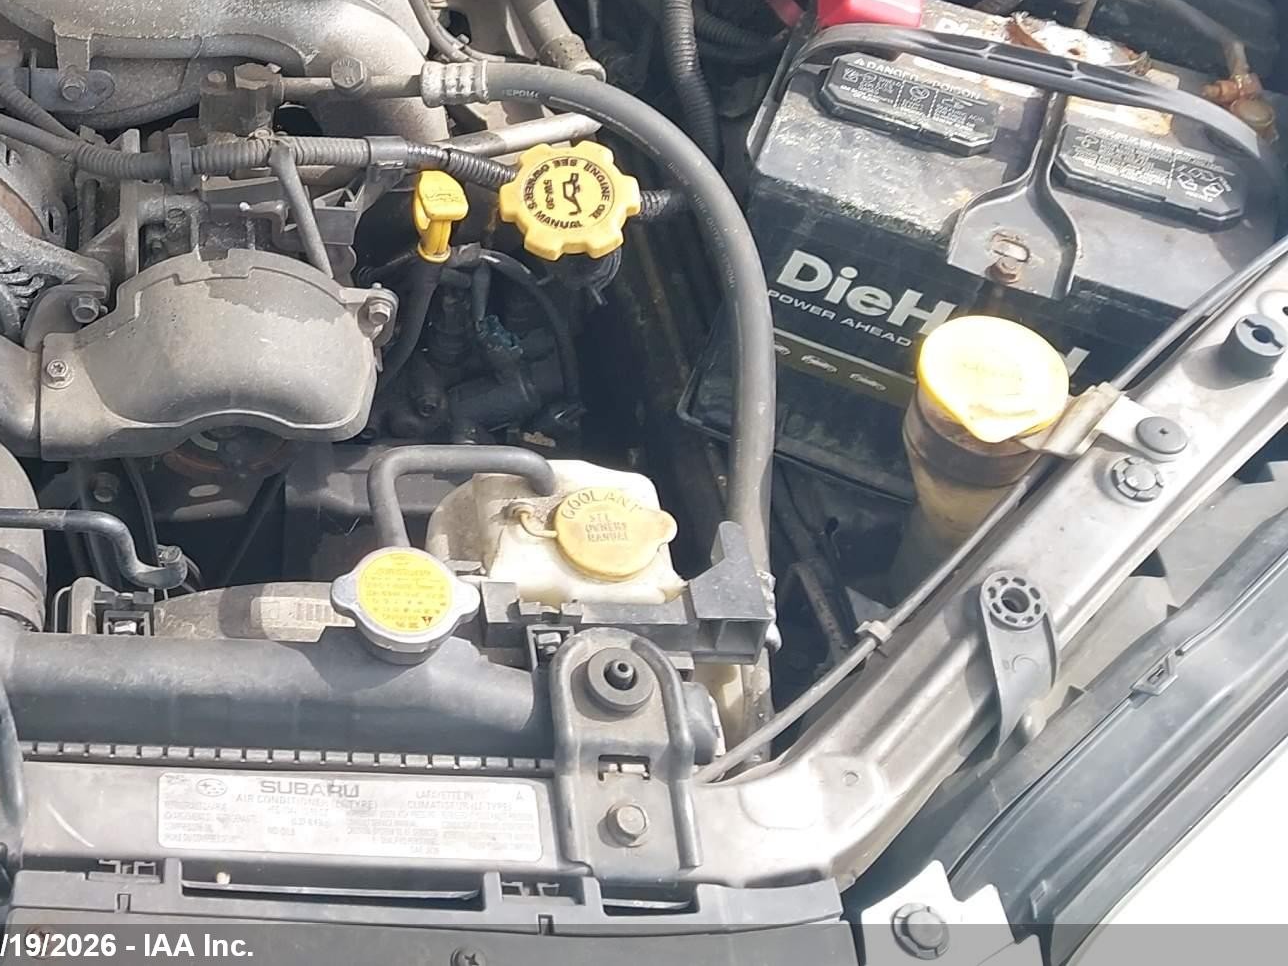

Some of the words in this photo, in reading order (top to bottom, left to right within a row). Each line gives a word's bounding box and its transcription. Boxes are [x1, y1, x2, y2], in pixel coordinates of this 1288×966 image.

[552, 158, 578, 169] SEE
[584, 162, 611, 201] ENGINE
[534, 210, 583, 229] MANUAL
[768, 289, 837, 321] POWER
[841, 317, 914, 348] AHEAD
[561, 490, 642, 520] COOLANT
[236, 794, 254, 803] AIR
[260, 780, 360, 799] SUBARU
